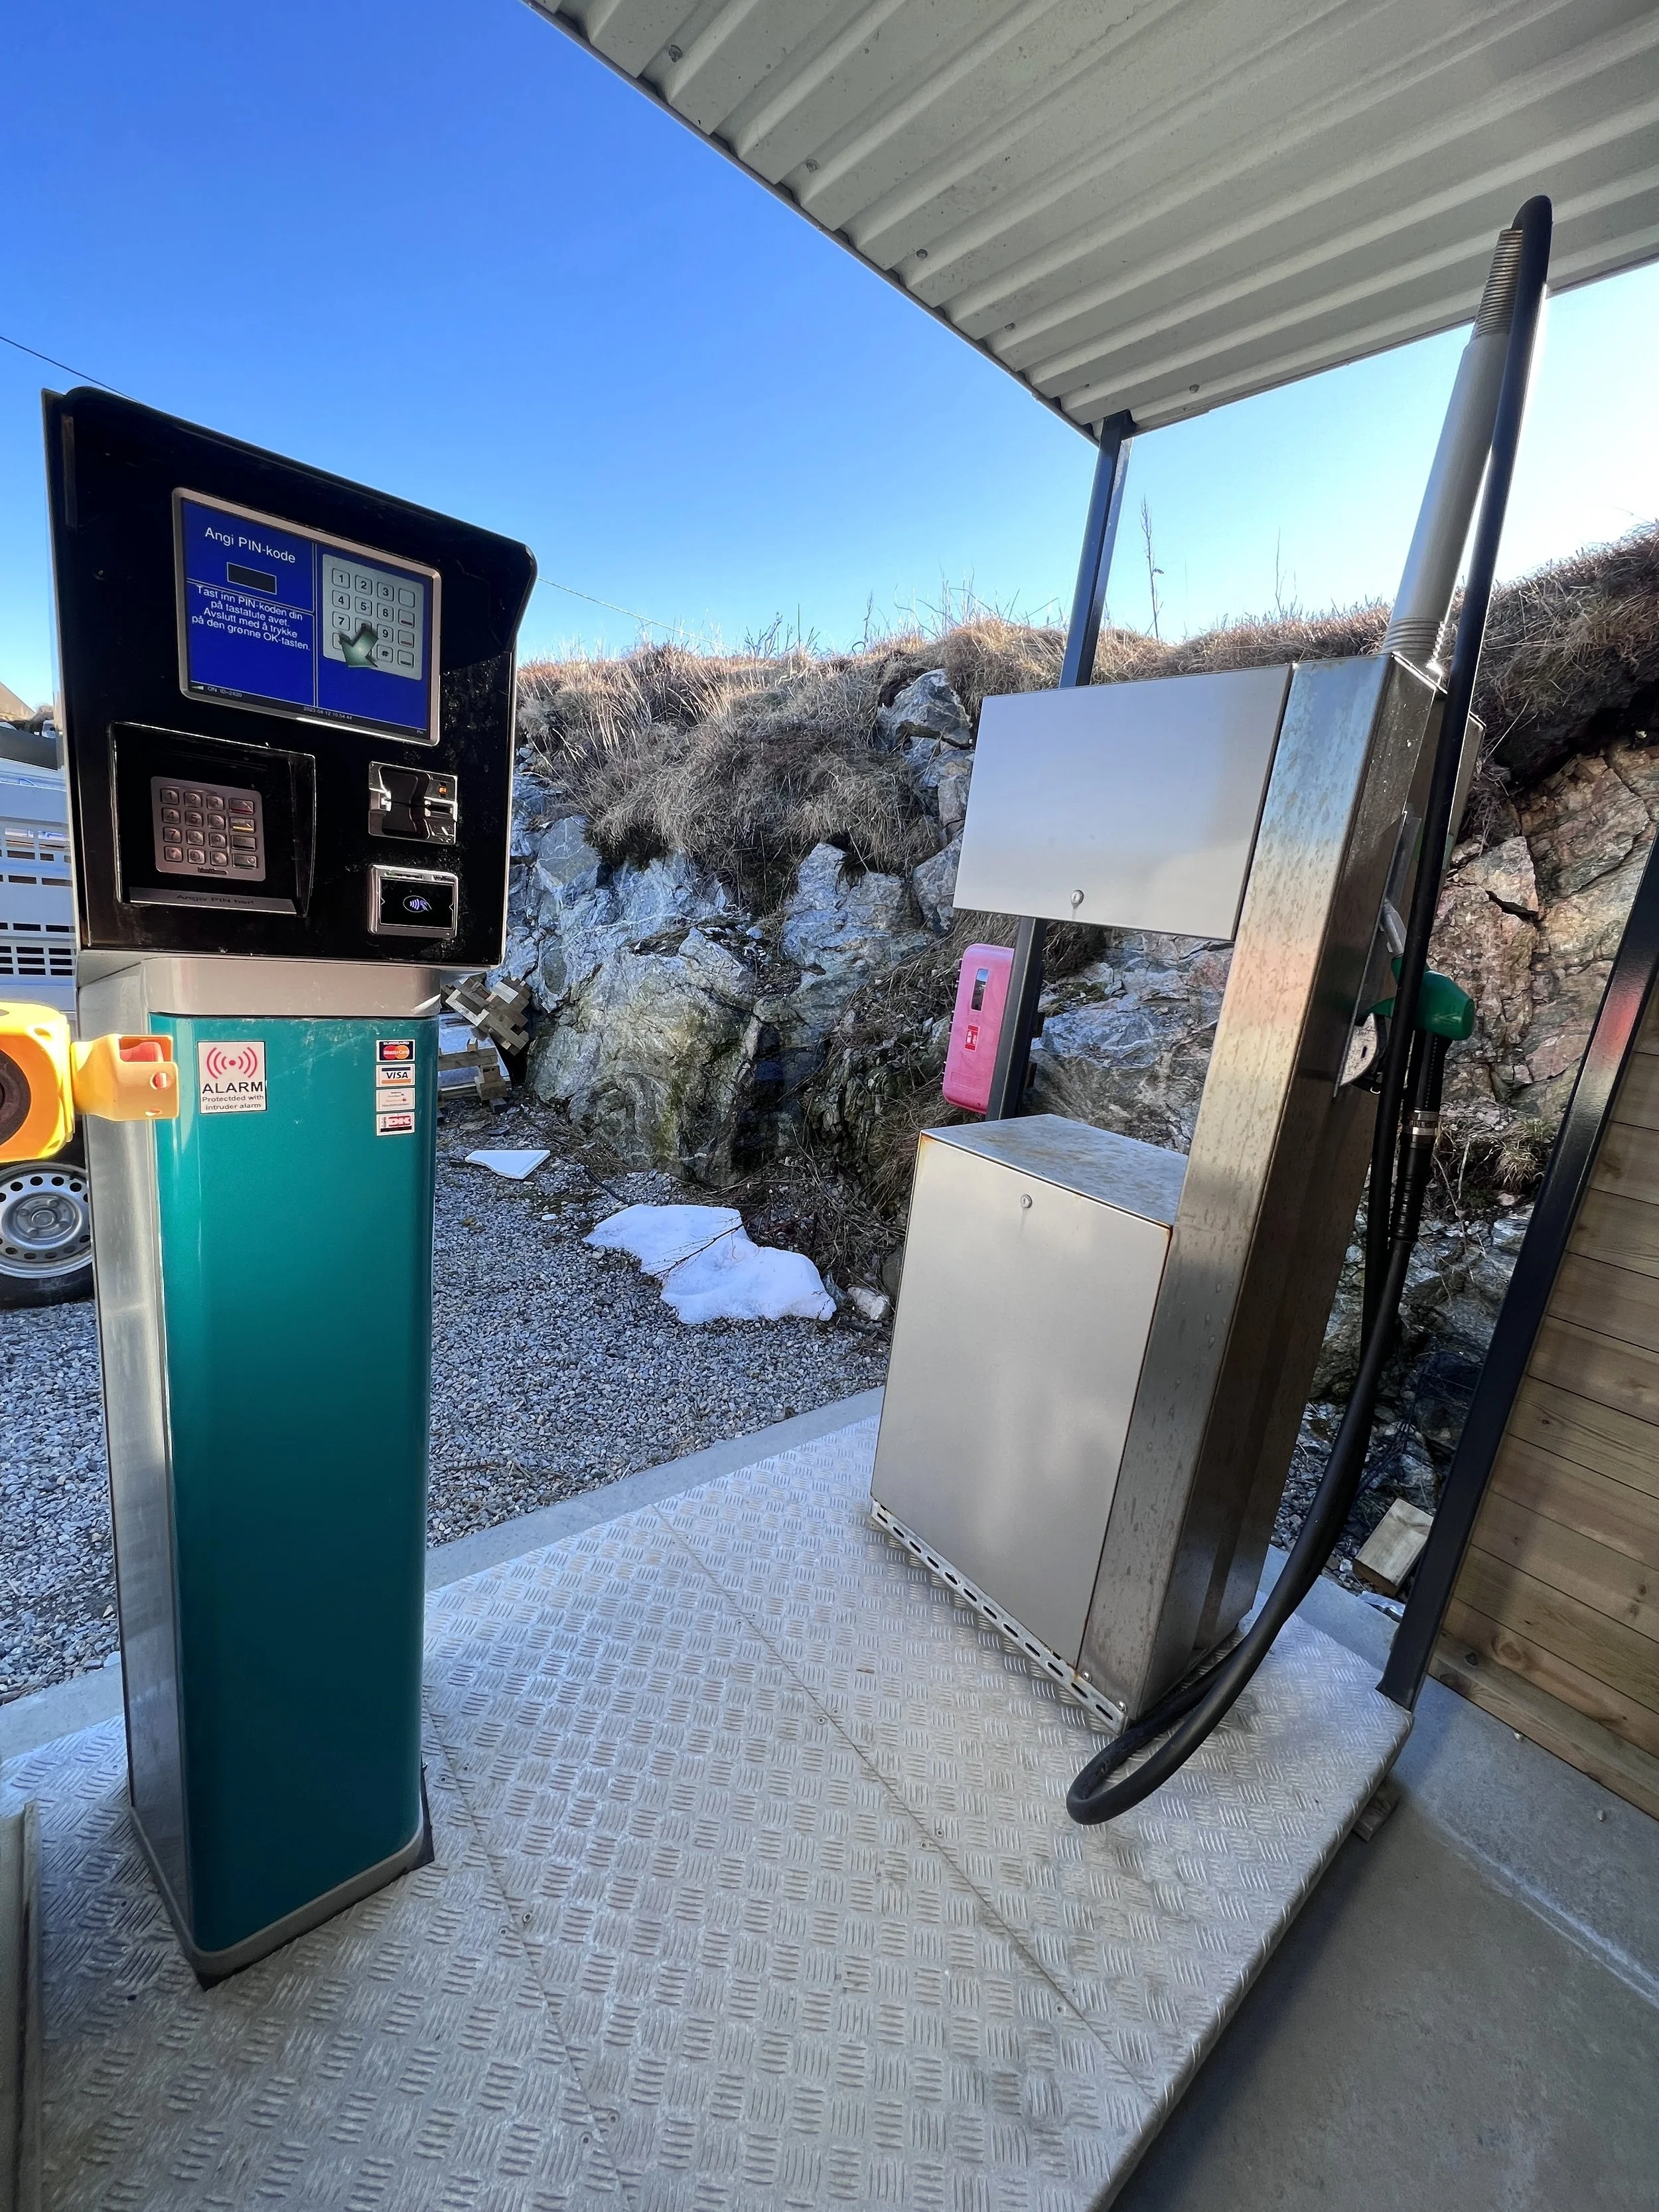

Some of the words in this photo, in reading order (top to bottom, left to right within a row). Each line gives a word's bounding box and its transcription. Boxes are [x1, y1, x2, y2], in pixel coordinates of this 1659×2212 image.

[205, 527, 234, 546] Angi
[238, 536, 296, 563] PIN-kode
[339, 574, 344, 583] 1
[360, 581, 367, 589] 2
[383, 587, 389, 596] 3
[196, 585, 218, 599] Tast
[220, 591, 236, 603] inn
[238, 596, 287, 617] PIN-koden
[289, 611, 303, 621] din
[211, 601, 223, 609] på
[338, 596, 344, 605] 4
[383, 609, 389, 617] 6
[192, 615, 204, 625] på
[207, 619, 225, 630] den
[263, 632, 311, 651] OK-tasten.
[204, 607, 236, 623] Avslutt
[239, 618, 259, 628] med
[262, 622, 268, 631] å
[270, 625, 298, 638] trykke
[338, 617, 345, 626] 7
[382, 629, 389, 638] 9
[169, 830, 176, 840] 7
[202, 1081, 263, 1094] ALARM
